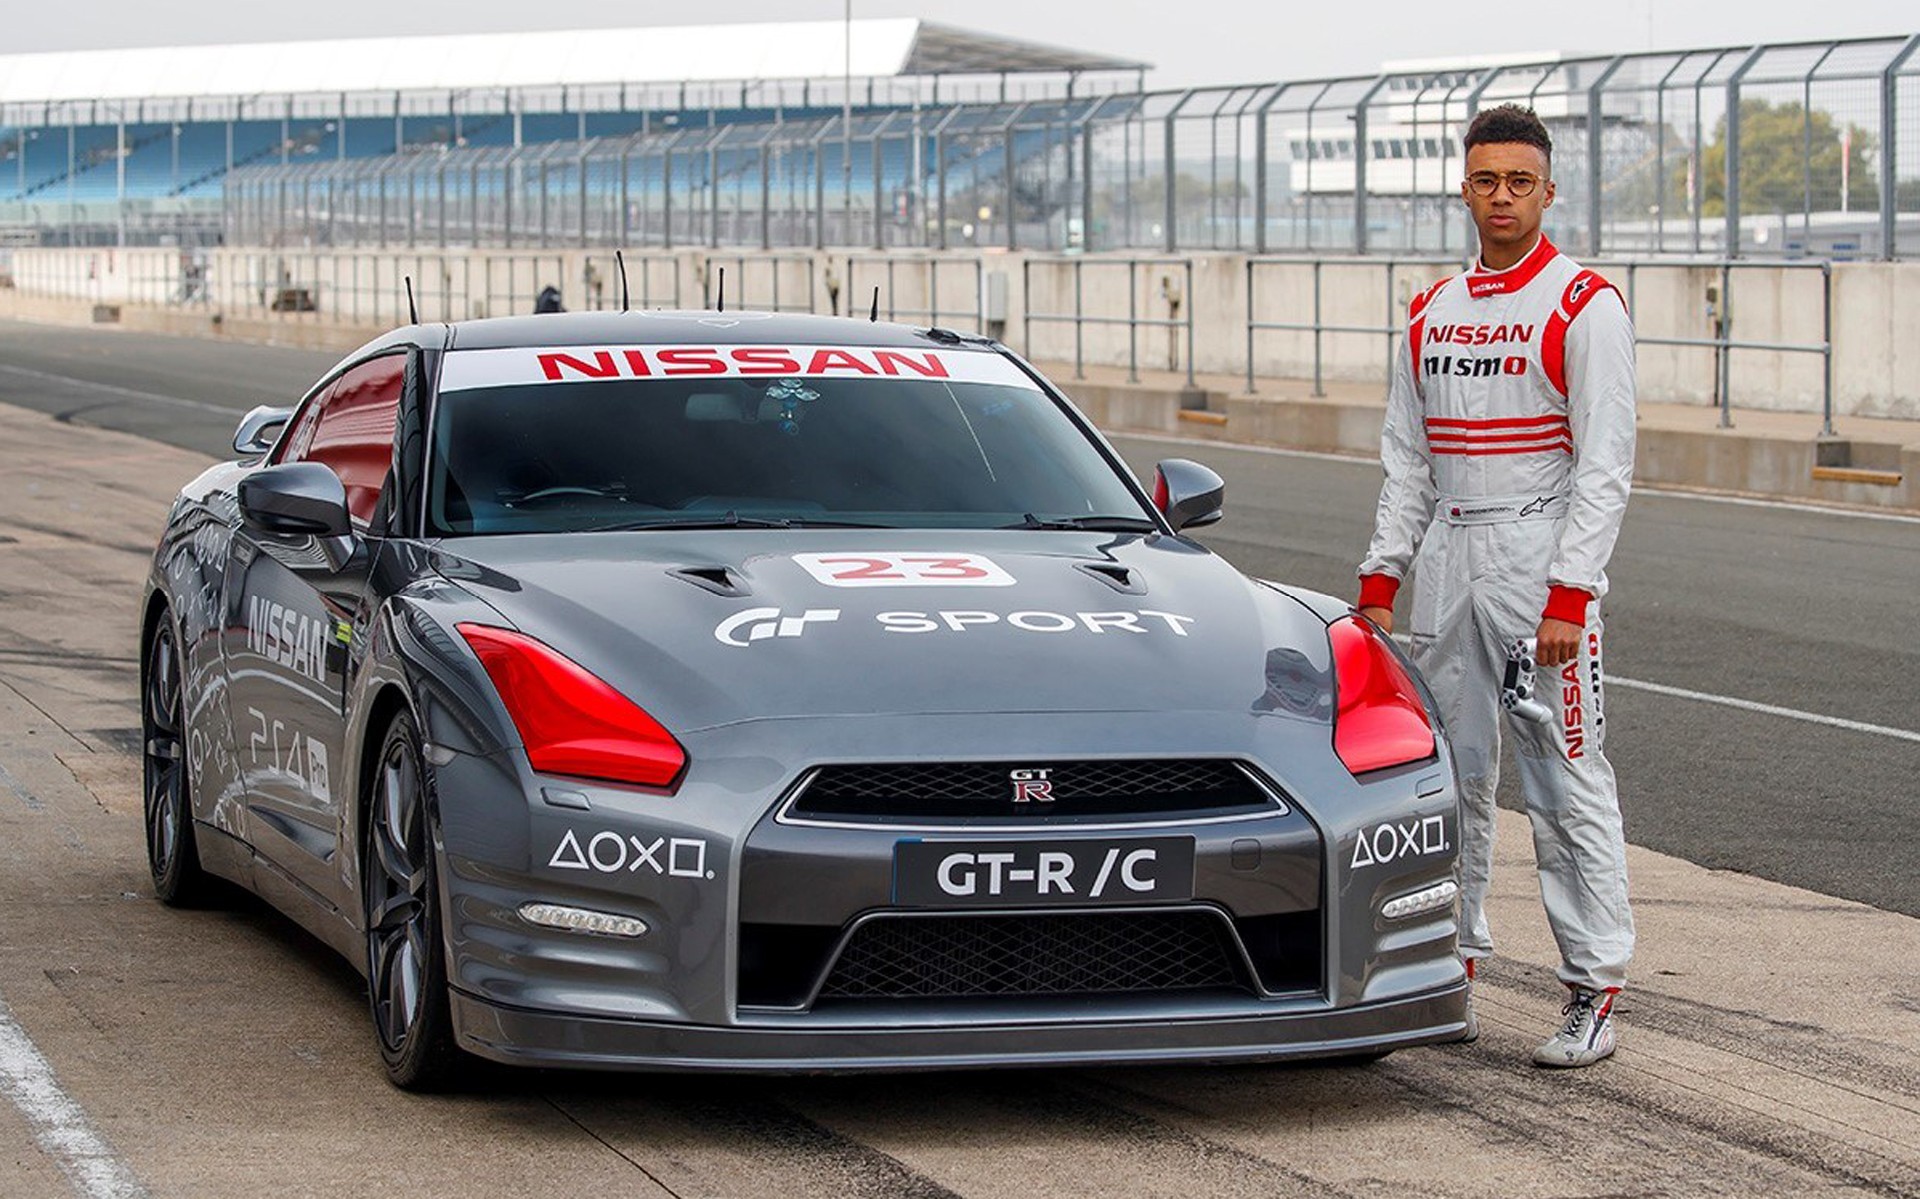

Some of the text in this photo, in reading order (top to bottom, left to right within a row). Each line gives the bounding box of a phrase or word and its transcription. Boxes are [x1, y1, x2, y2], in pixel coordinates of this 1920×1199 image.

[1472, 282, 1505, 293] NISSAN
[1426, 324, 1534, 345] NISSAN
[536, 349, 950, 380] NISSAN
[1424, 356, 1527, 376] nismo
[818, 558, 989, 580] 23
[876, 611, 1196, 637] SPORT
[248, 594, 330, 682] NISSAN
[1561, 660, 1584, 760] NISSA
[1009, 768, 1053, 780] GT
[1012, 779, 1056, 803] R
[937, 849, 1156, 897] GT-R /C
